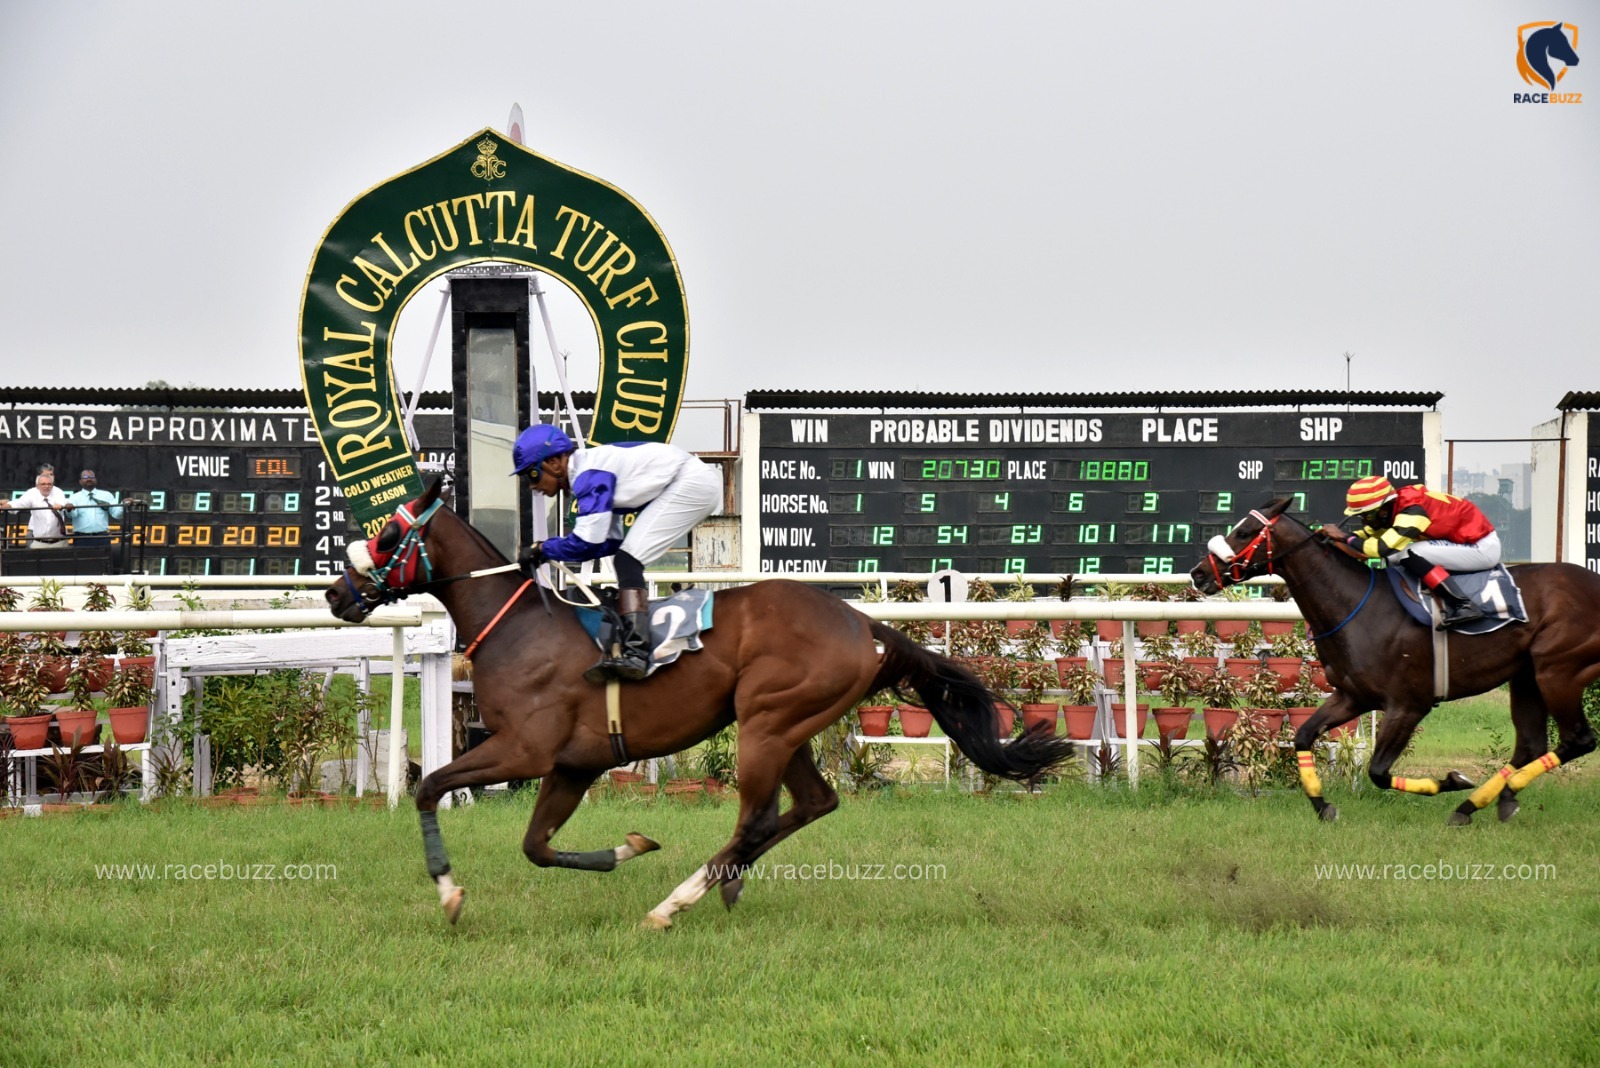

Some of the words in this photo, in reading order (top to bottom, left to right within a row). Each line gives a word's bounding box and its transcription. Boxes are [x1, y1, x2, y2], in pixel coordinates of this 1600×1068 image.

[335, 190, 538, 314] CALCUTTA
[550, 205, 660, 310] TURF
[610, 320, 669, 435] CLUB
[323, 321, 393, 465] ROYAL
[108, 415, 320, 442] APPROXIMATE
[791, 419, 829, 443] WIN
[870, 419, 980, 443] PROBABLE
[989, 419, 1104, 443] DIVIDENDS
[1141, 417, 1218, 442] PLACE
[1300, 417, 1343, 441] SHP
[176, 455, 230, 478] VENUE
[255, 459, 293, 475] CAL
[761, 460, 797, 480] RACE
[800, 460, 822, 480] No.
[868, 461, 895, 480] WIN
[922, 460, 1001, 479] 20730
[1007, 460, 1047, 480] PLACE
[1079, 461, 1149, 480] 18880
[1238, 460, 1264, 480] SHP
[1301, 460, 1373, 480] 12350
[1383, 461, 1419, 480] POOL
[343, 481, 371, 498] COLD
[369, 465, 414, 488] WEATHER
[194, 491, 212, 513] 6
[240, 492, 257, 513] 7
[283, 492, 300, 513] 8
[369, 484, 408, 507] SEASON
[762, 494, 808, 514] HORSE
[920, 493, 936, 512] 5
[995, 492, 1009, 511] 4
[1068, 492, 1084, 511] 6
[1142, 492, 1158, 511] 3
[1216, 492, 1233, 511] 2
[1293, 492, 1306, 511] 7
[178, 525, 211, 546] 20
[223, 525, 257, 546] 20
[267, 526, 301, 546] 20
[762, 527, 788, 547] WIN
[790, 528, 816, 547] DIV.
[872, 526, 895, 545] 12
[937, 525, 967, 544] 54
[761, 559, 801, 573] PLACE
[938, 575, 951, 602] 1
[650, 605, 690, 660] 2
